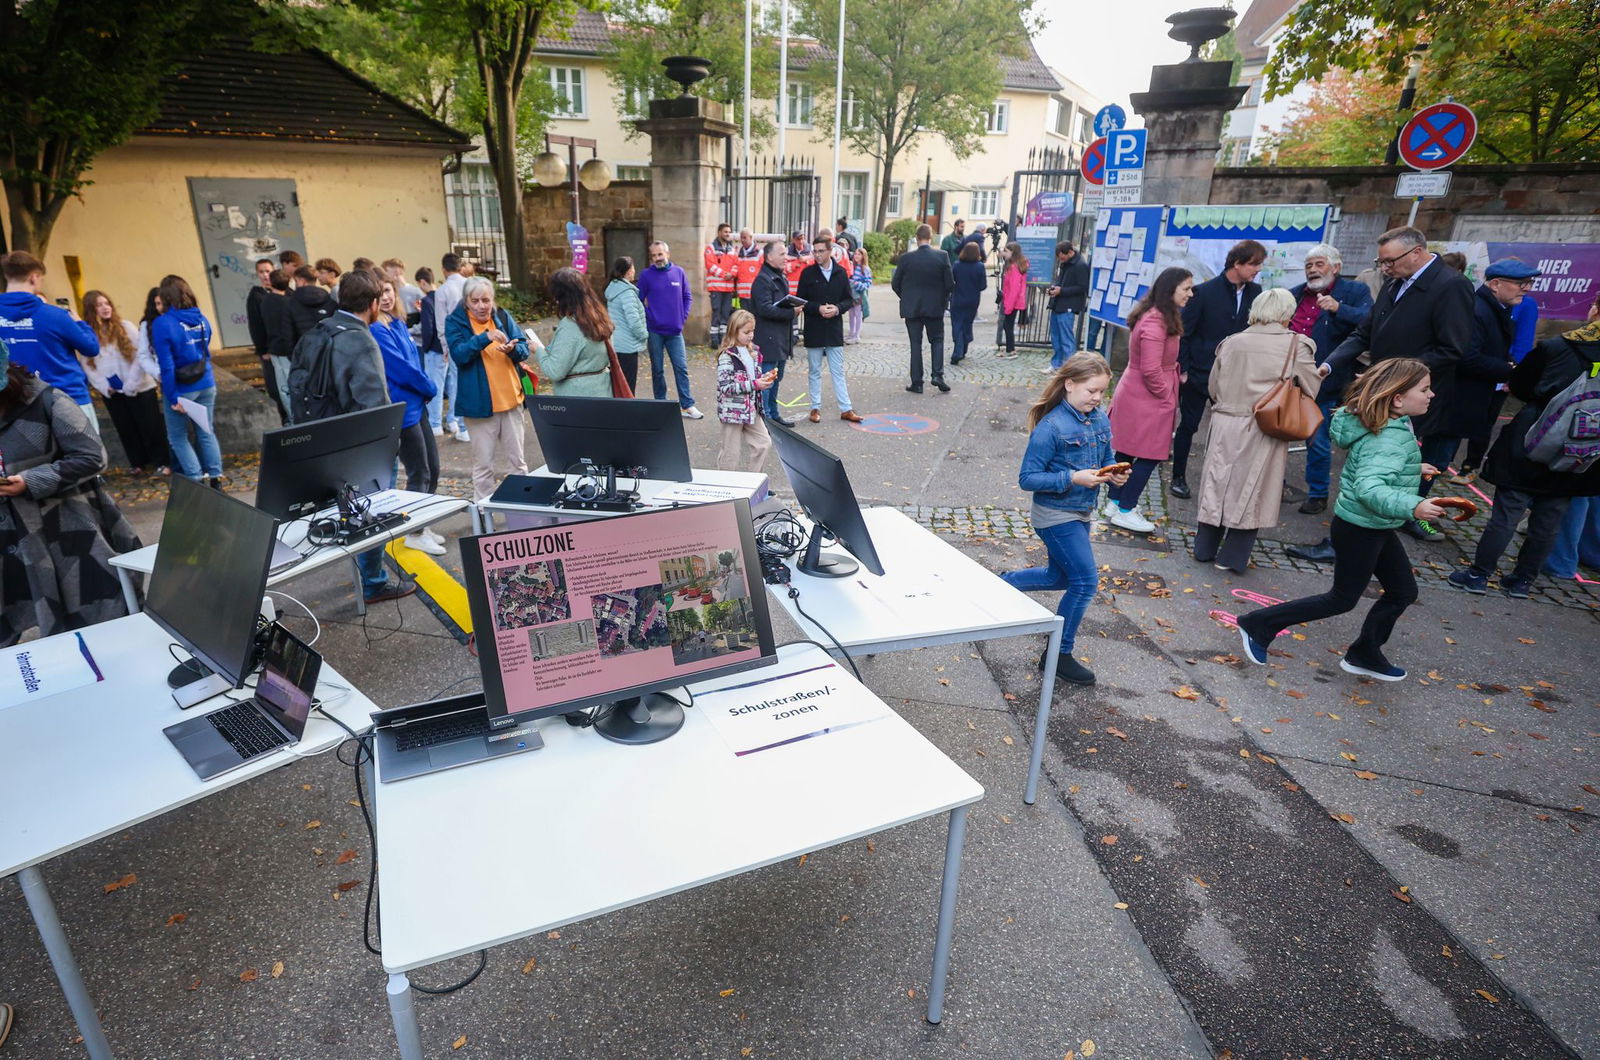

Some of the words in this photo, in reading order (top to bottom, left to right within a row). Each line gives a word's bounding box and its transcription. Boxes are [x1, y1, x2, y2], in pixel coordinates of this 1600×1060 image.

[1114, 134, 1137, 165] P
[1106, 188, 1139, 196] werktags
[1537, 259, 1572, 275] HIER
[1531, 277, 1552, 292] EN
[1554, 277, 1593, 293] WIR!
[538, 403, 566, 412] Lenovo
[281, 434, 312, 446] Lenovo
[484, 532, 575, 563] SCHULZONE
[729, 685, 837, 717] Schulstraßen/-
[772, 704, 819, 721] zonen
[493, 717, 515, 727] Lenovo
